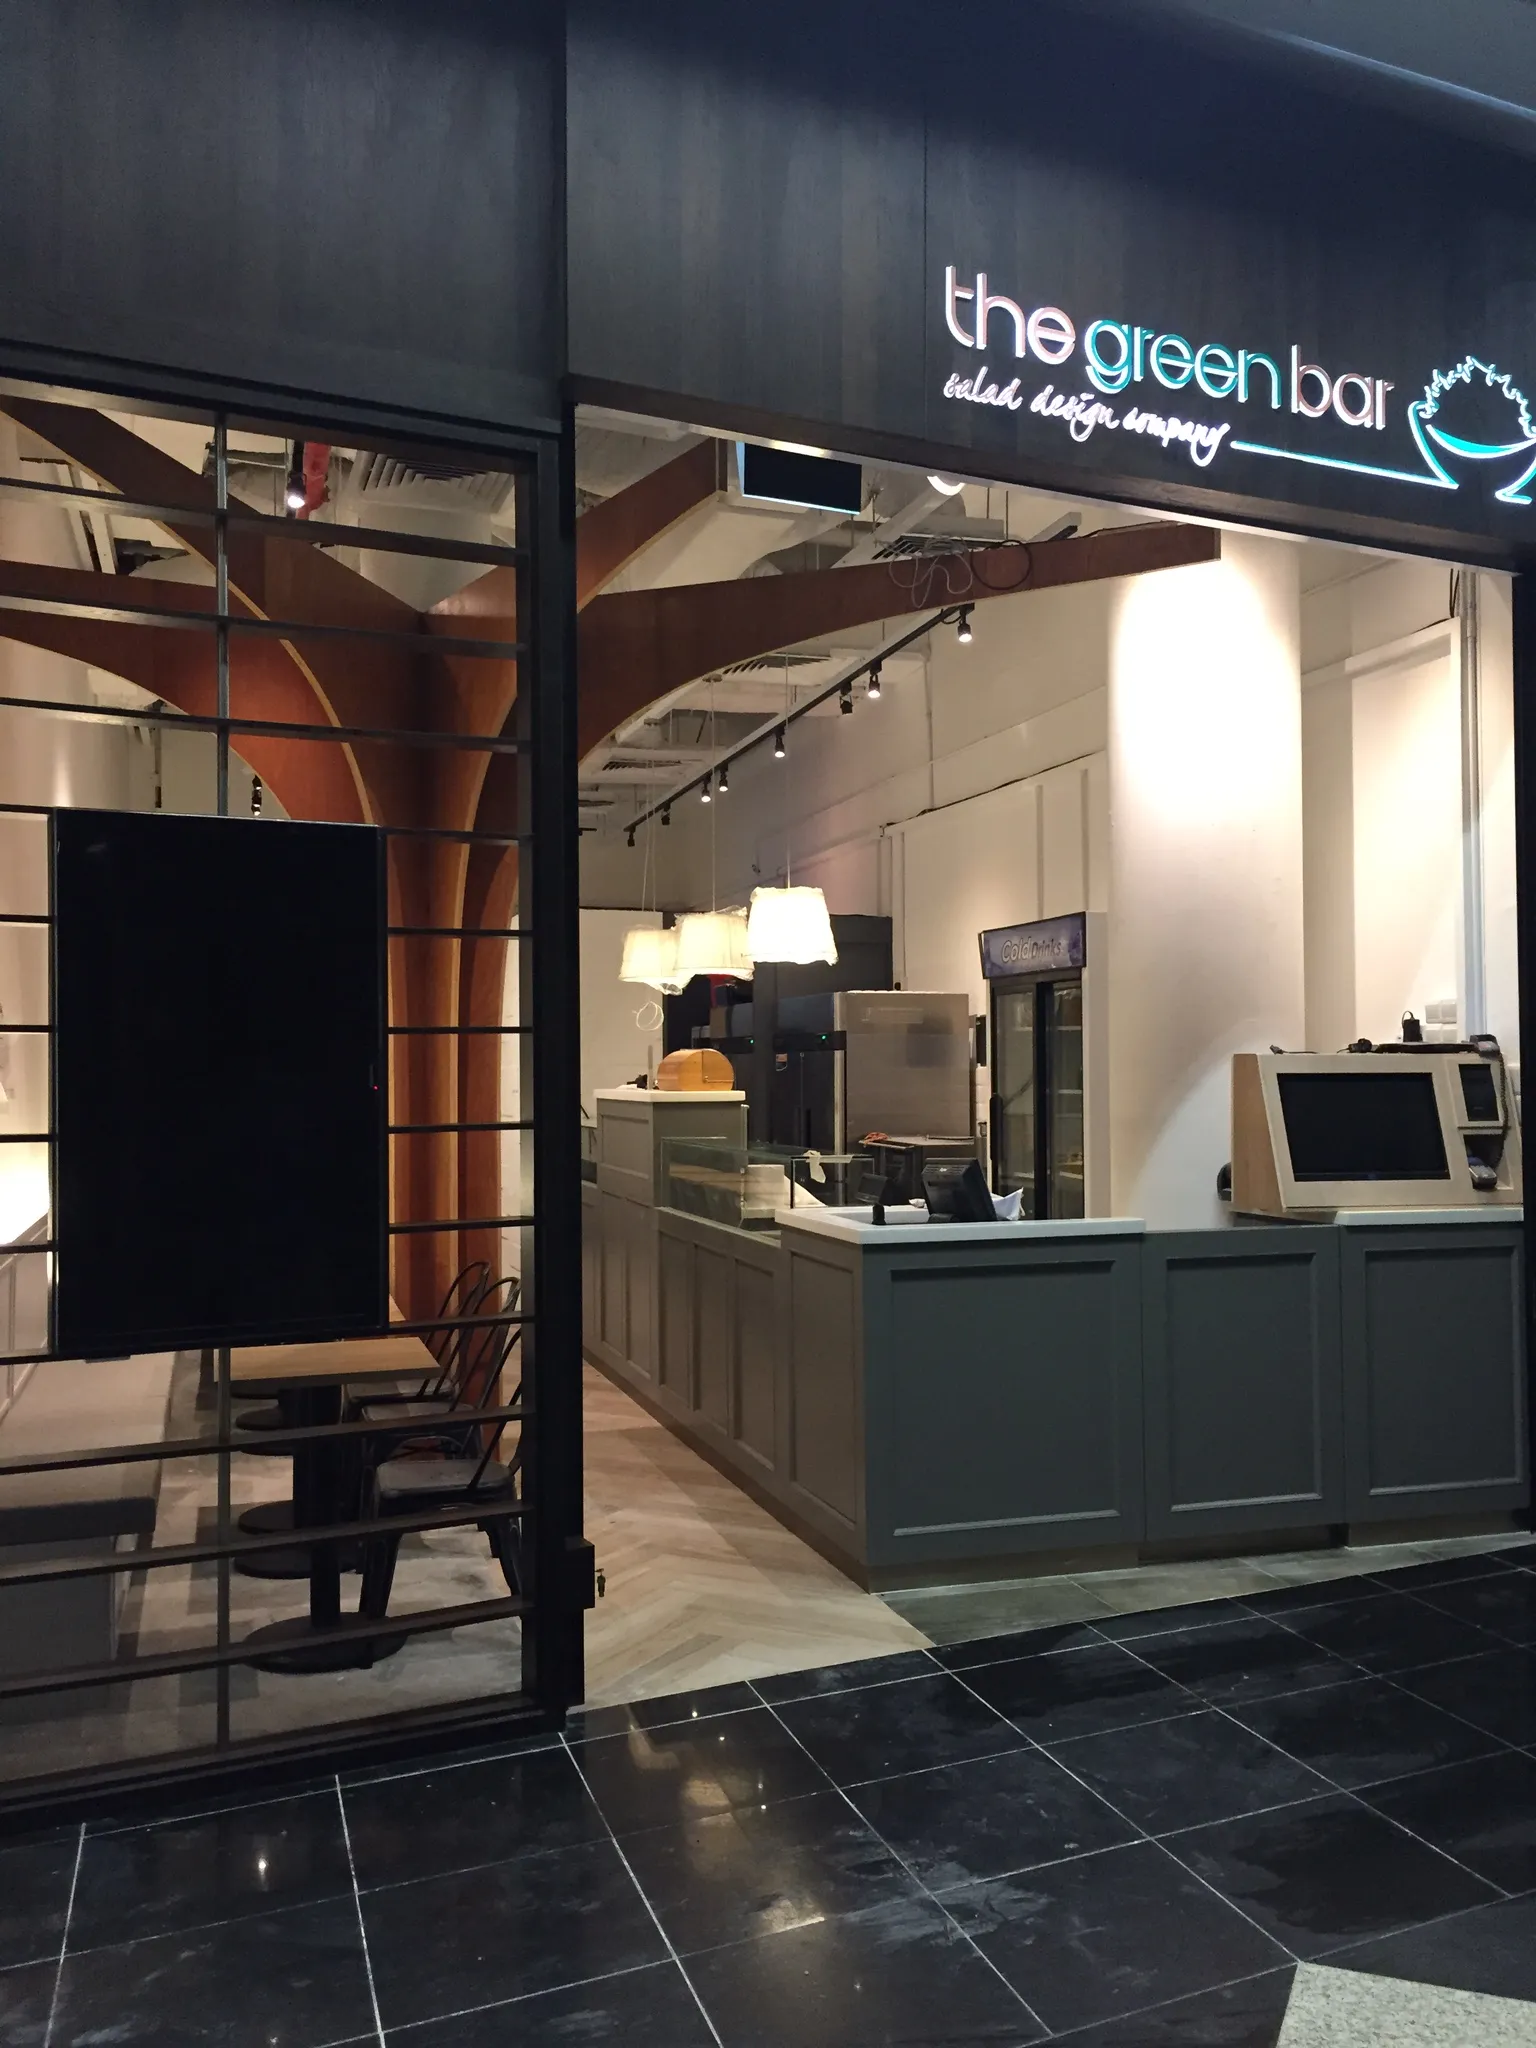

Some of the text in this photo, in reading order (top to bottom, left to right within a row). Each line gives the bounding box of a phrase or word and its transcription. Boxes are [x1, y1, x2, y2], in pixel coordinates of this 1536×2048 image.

[945, 265, 1396, 431] the green bar
[943, 366, 1231, 467] salad design company
